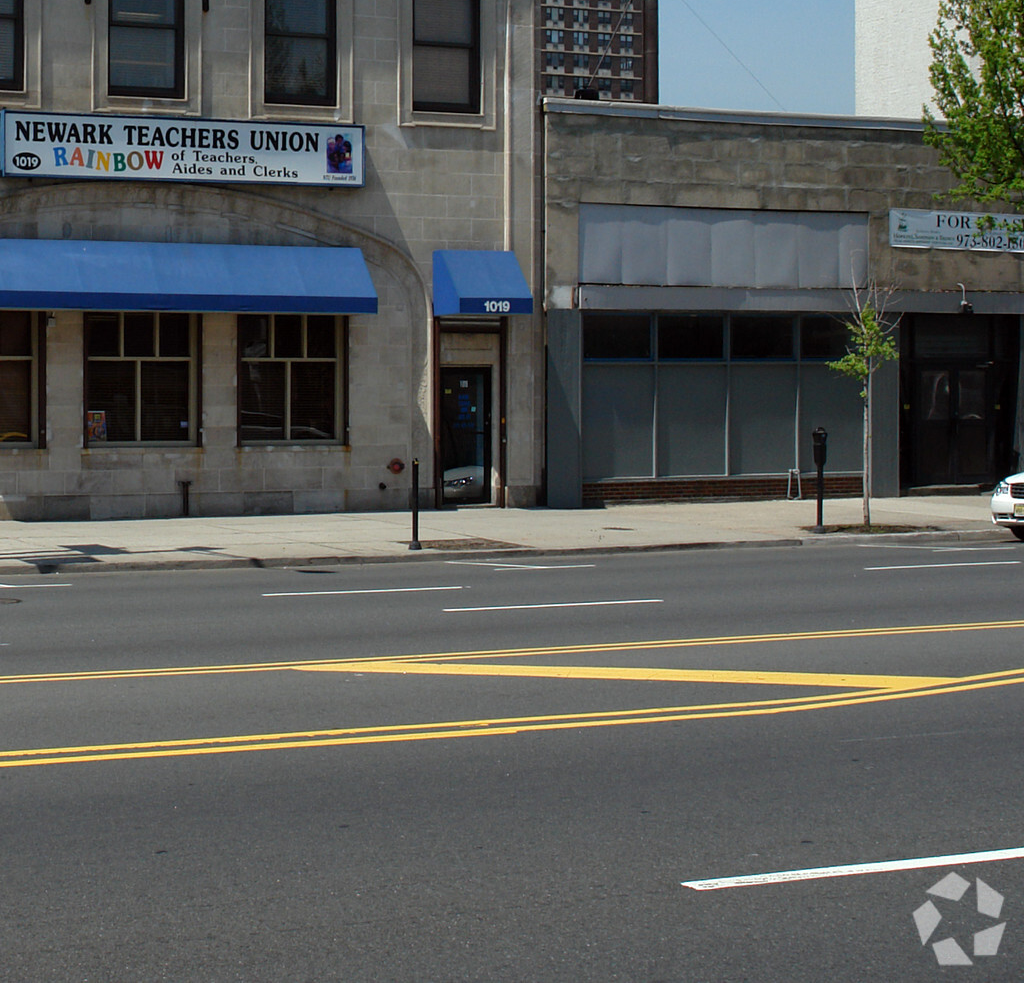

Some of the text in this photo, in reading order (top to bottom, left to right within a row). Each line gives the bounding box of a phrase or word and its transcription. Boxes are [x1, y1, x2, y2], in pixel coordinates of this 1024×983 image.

[15, 120, 319, 153] NEWARK TEACHERS UNION
[15, 156, 39, 167] 1019
[53, 146, 164, 172] RAINBOW
[171, 150, 185, 161] of
[172, 162, 299, 178] Aides and Clerks
[936, 214, 971, 229] FOR
[484, 300, 511, 313] 1019
